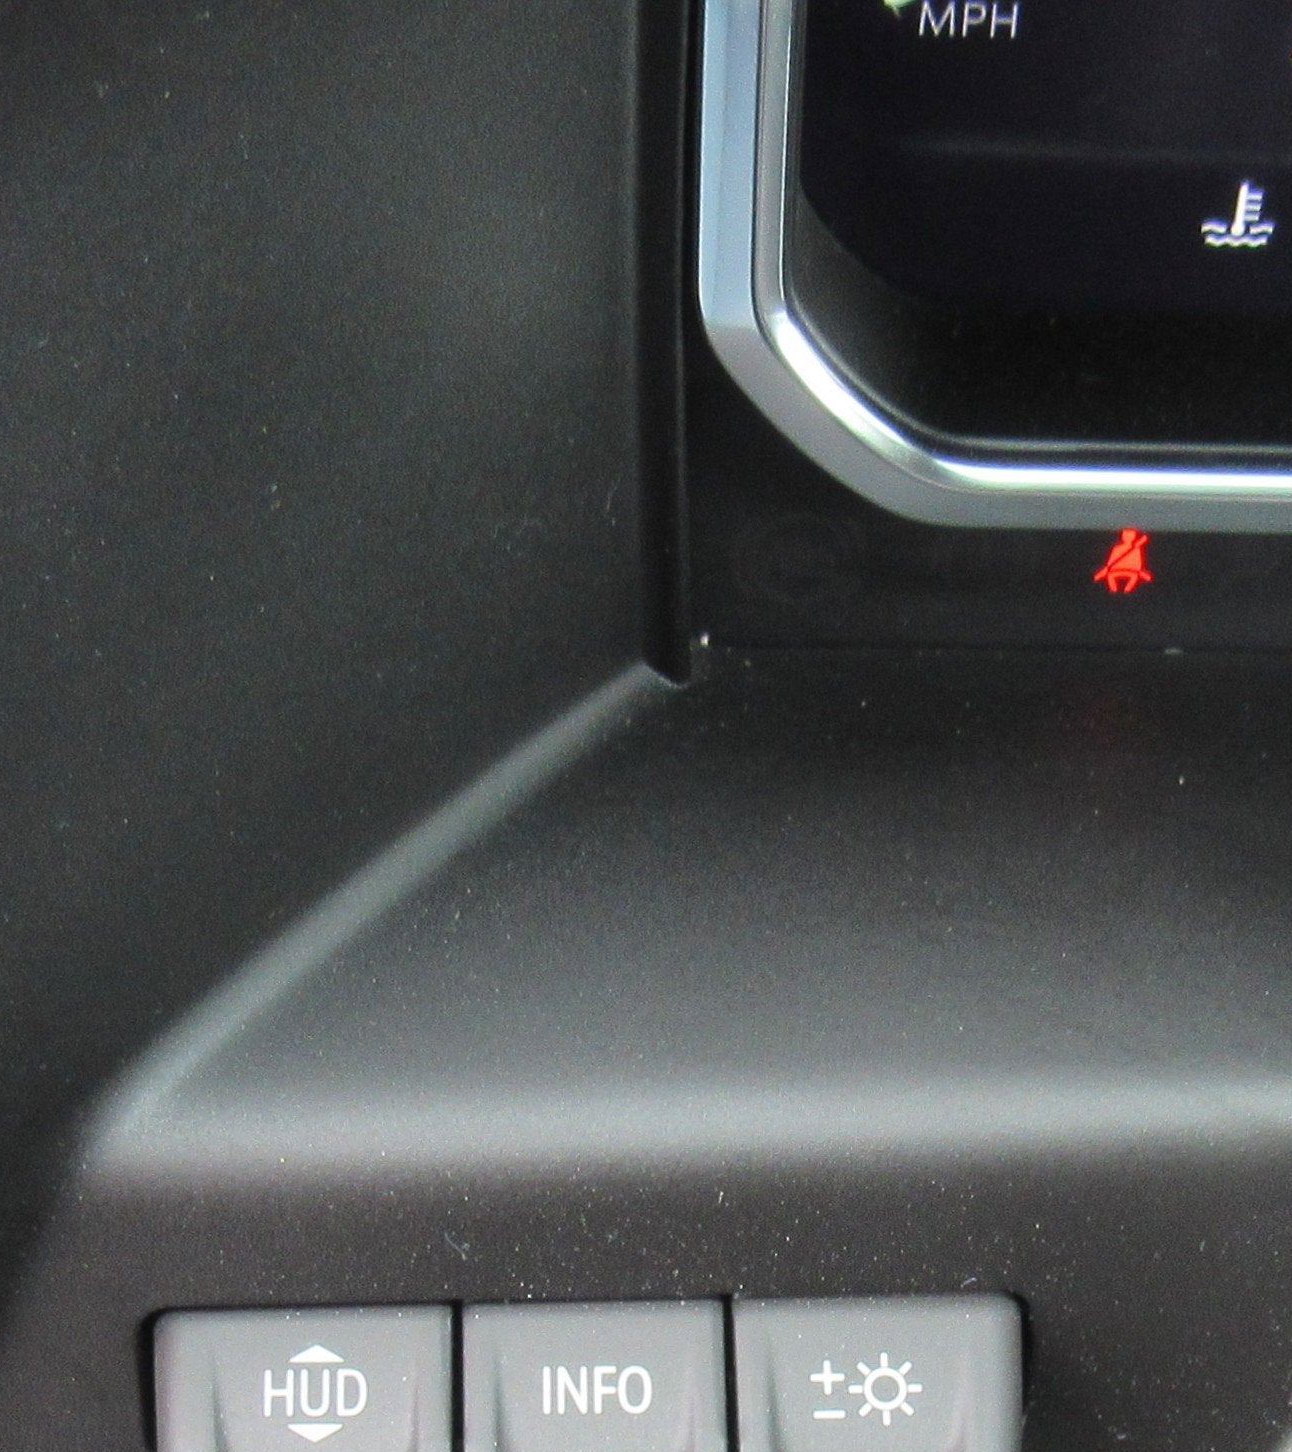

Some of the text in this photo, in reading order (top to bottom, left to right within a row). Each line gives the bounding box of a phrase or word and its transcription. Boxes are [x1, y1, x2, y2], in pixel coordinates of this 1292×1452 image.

[917, 0, 1020, 39] MPH
[262, 1369, 368, 1417] HUD
[541, 1365, 654, 1414] INFO
